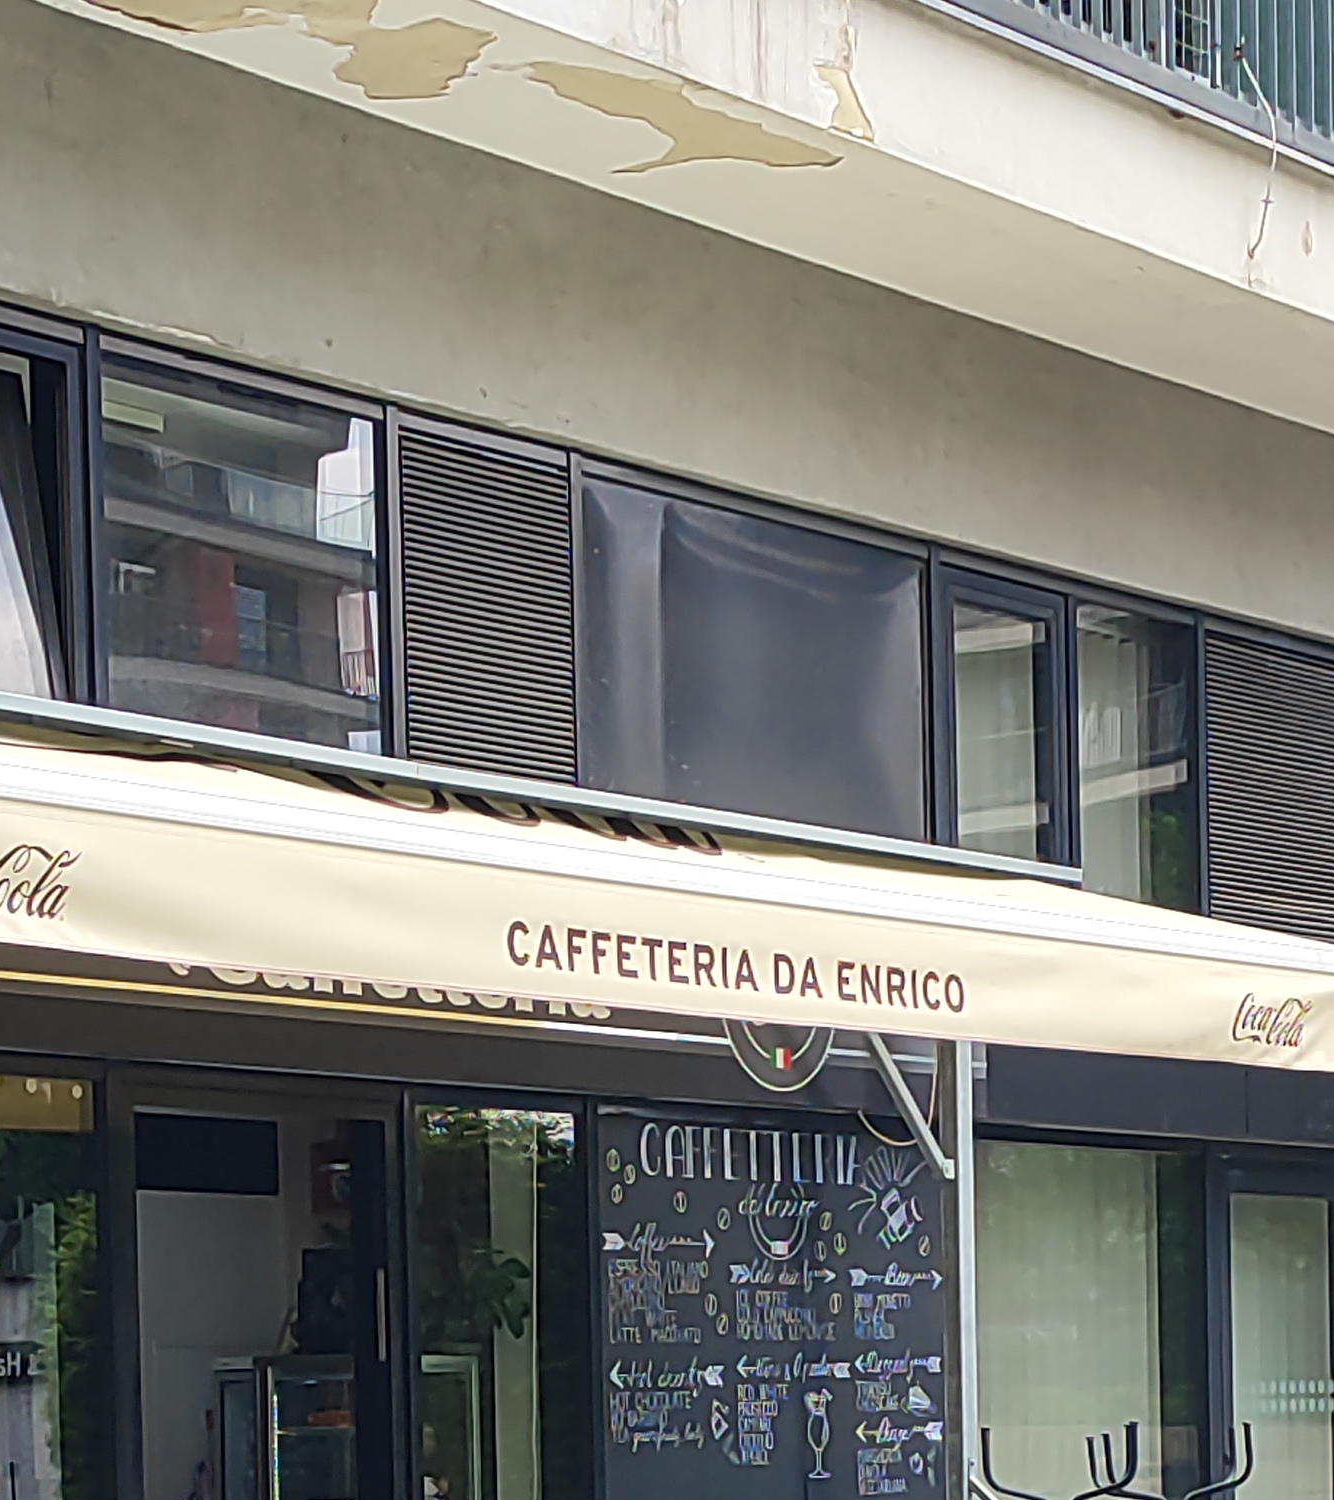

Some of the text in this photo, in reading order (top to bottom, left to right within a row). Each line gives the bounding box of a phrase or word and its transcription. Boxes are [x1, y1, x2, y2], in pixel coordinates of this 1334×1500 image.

[507, 921, 759, 992] CAFFETERIA
[773, 953, 823, 999] DA
[837, 960, 965, 1013] ENRICO
[1232, 993, 1313, 1048] Coca-Cola
